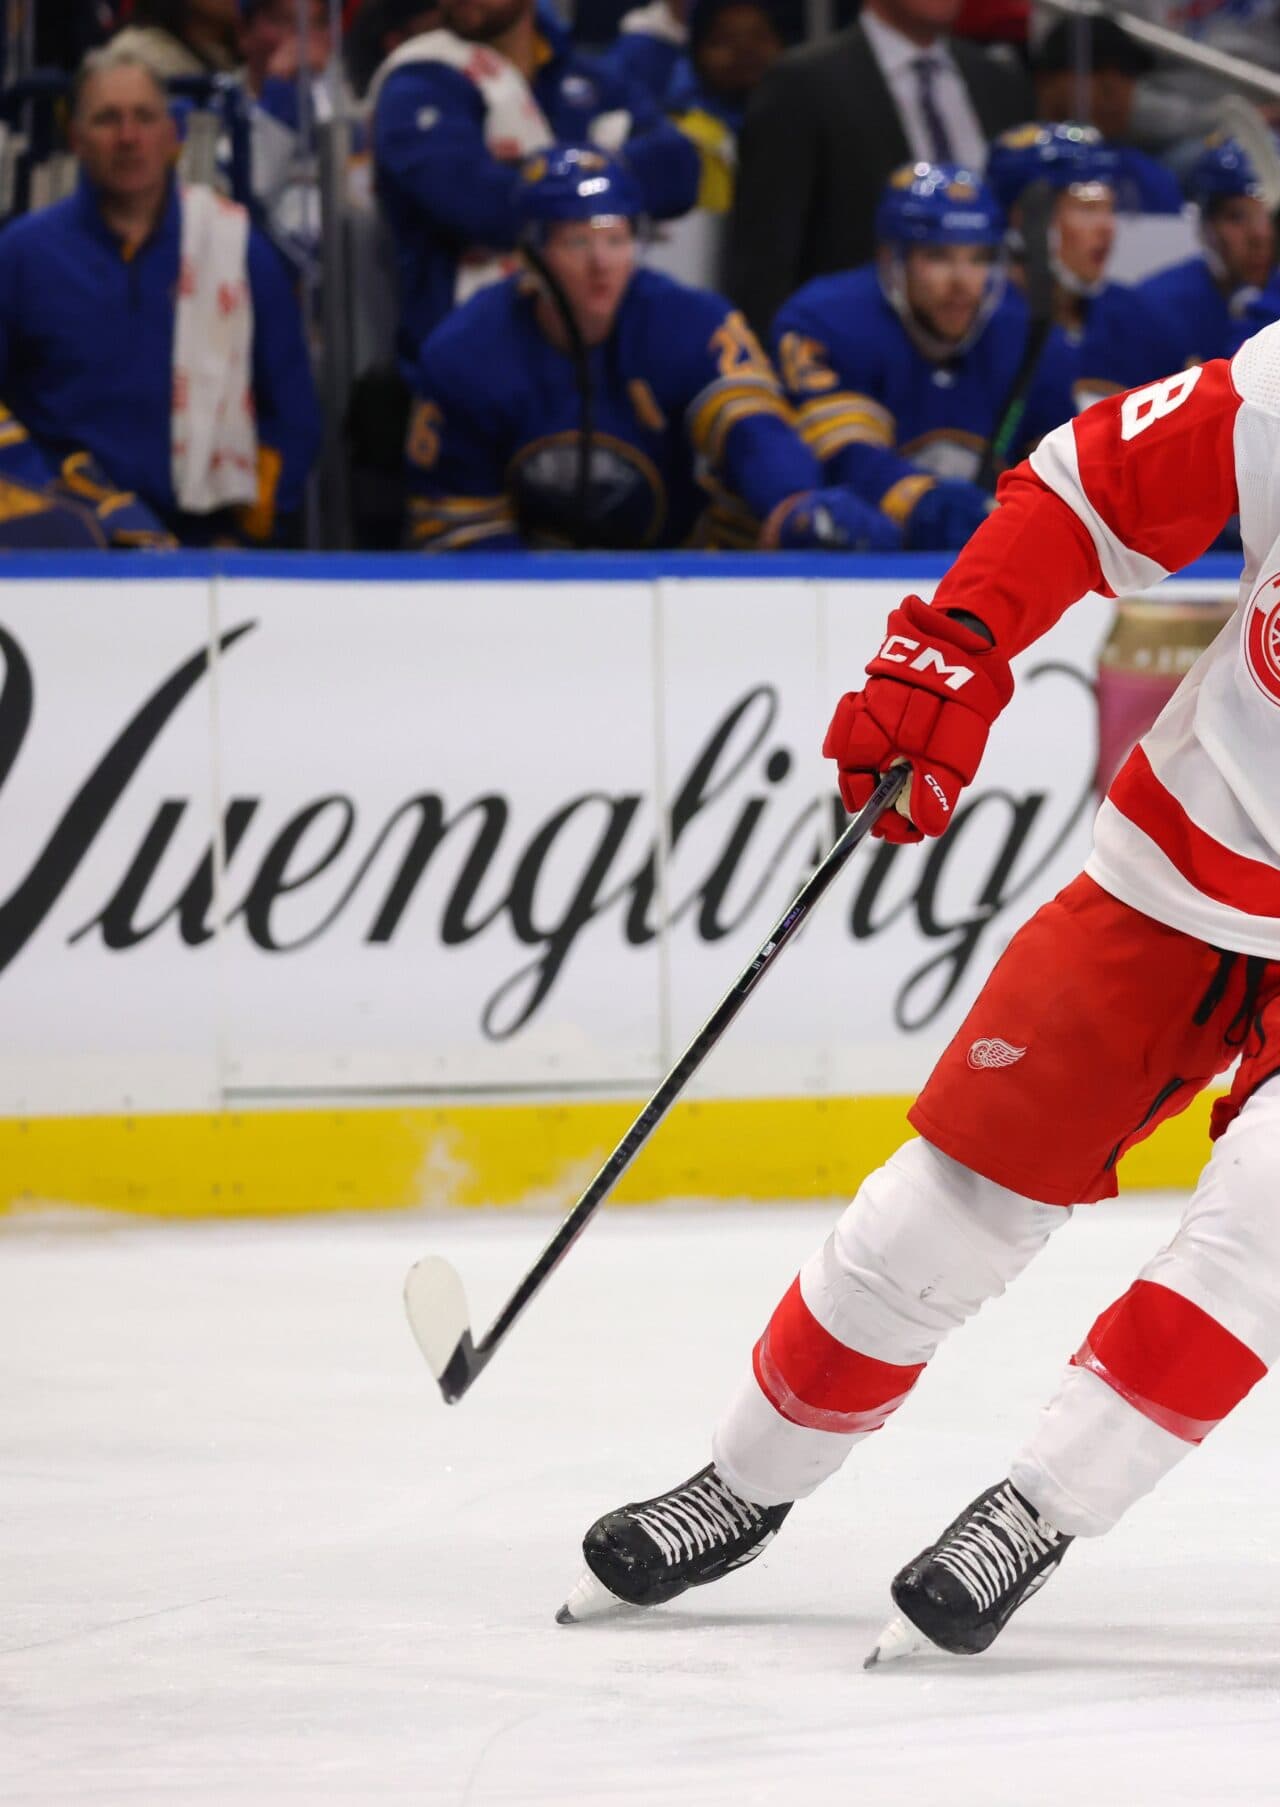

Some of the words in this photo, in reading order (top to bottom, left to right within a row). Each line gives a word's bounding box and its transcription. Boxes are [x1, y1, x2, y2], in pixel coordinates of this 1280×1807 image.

[1121, 365, 1204, 441] 8
[879, 633, 976, 691] CM
[924, 773, 950, 812] CCM
